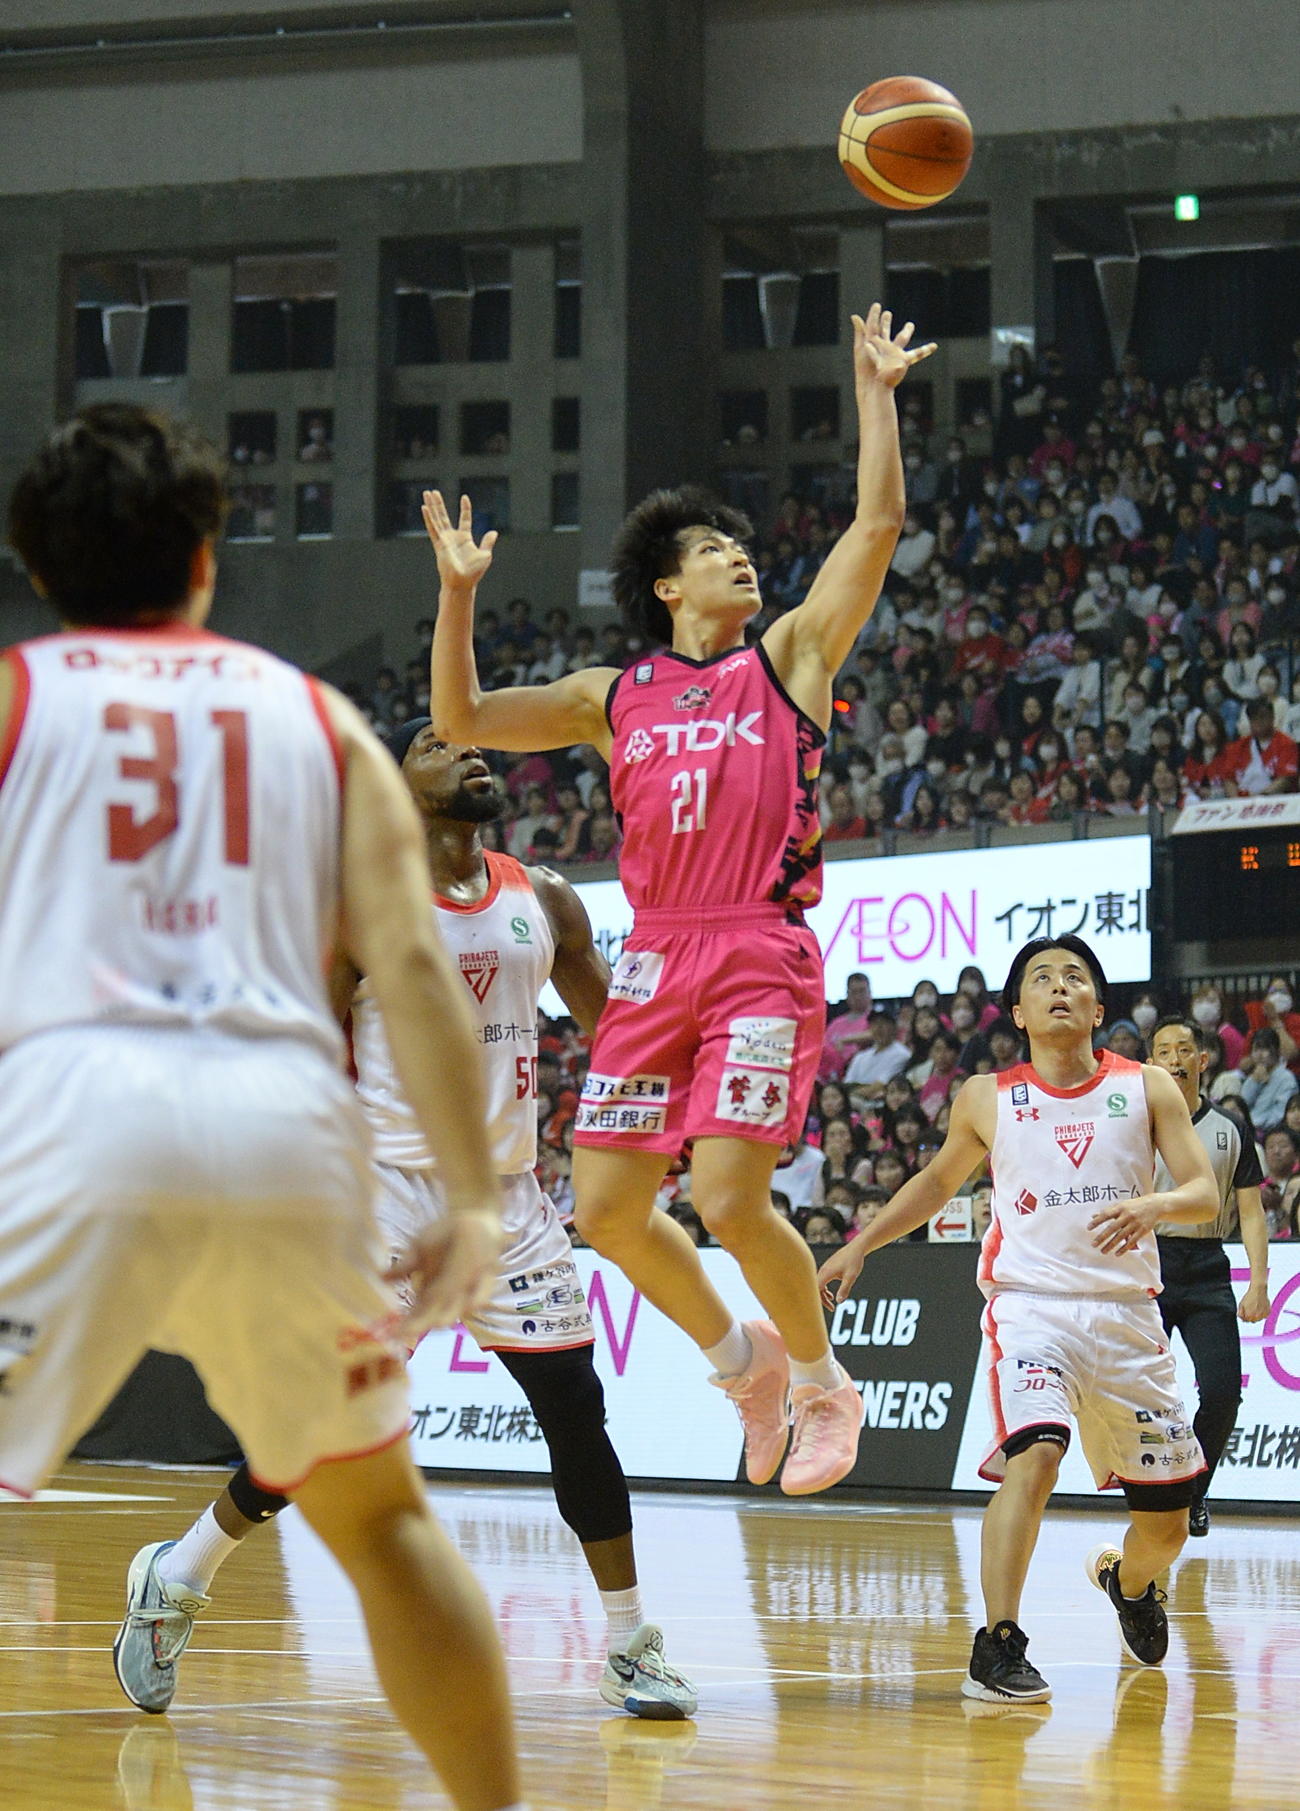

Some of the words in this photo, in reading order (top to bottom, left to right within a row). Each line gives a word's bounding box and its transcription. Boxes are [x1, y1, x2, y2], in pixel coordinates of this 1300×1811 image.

[653, 711, 765, 756] TDK
[105, 703, 249, 866] 31
[671, 768, 707, 834] 21
[822, 889, 977, 963] AEON
[1043, 1184, 1141, 1208] 金太郎ホーム
[830, 1299, 921, 1346] CLUB
[853, 1380, 953, 1430] NERS
